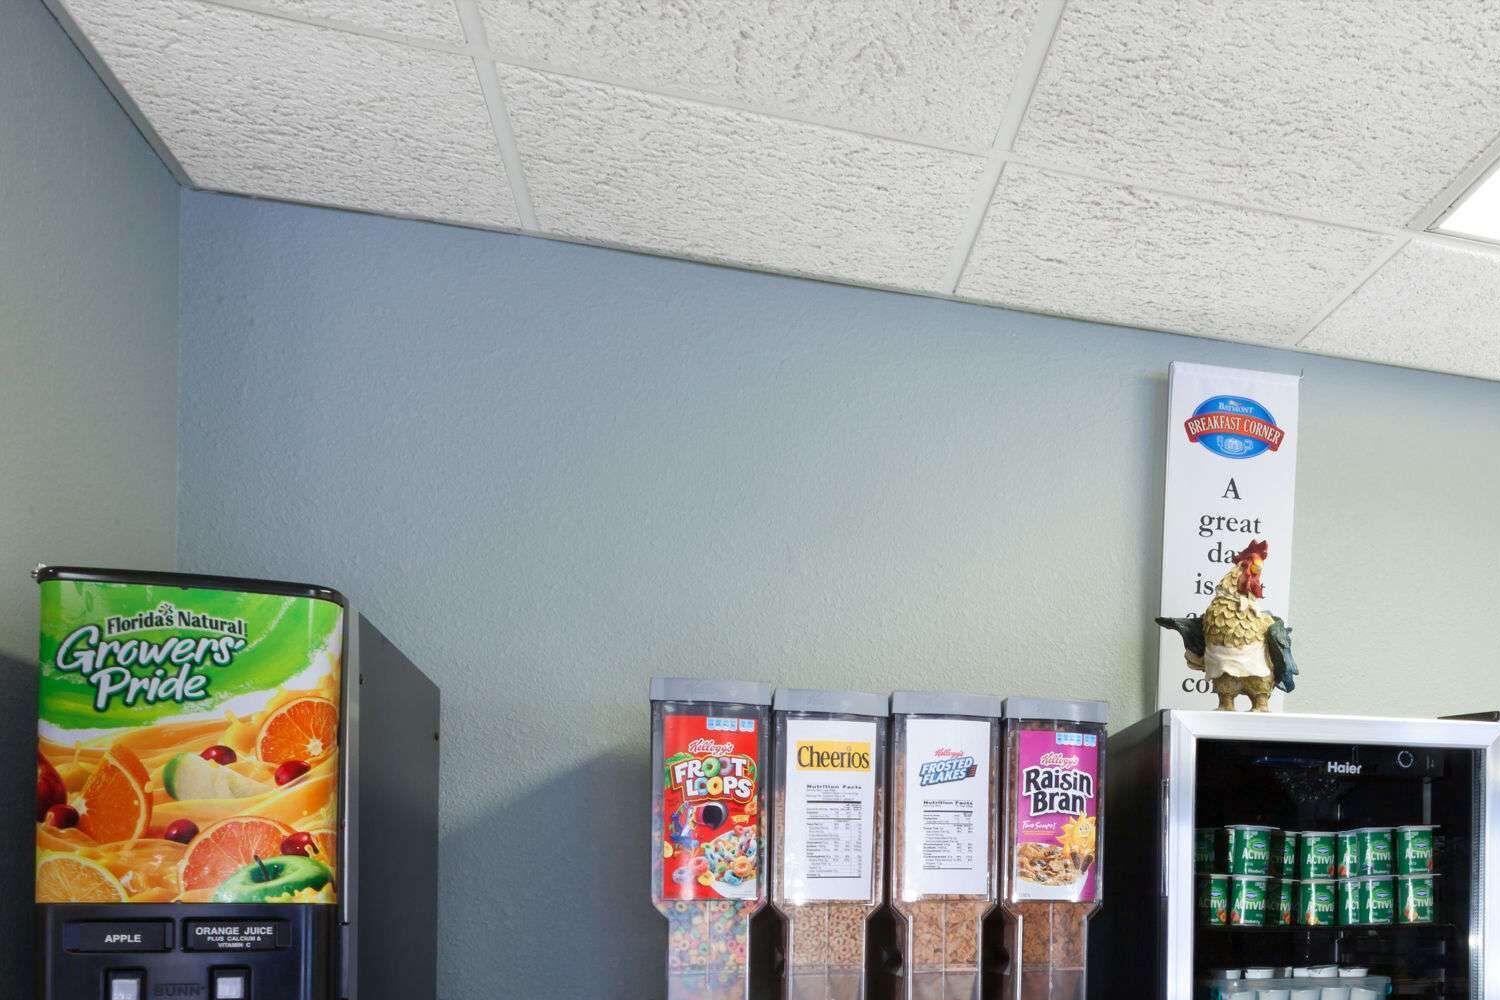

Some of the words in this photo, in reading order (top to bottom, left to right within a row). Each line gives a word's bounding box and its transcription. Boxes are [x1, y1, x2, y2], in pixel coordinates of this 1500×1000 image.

[1188, 416, 1242, 435] BREAKFAST
[1243, 419, 1281, 444] CORNER
[1222, 477, 1242, 500] A
[1199, 514, 1261, 538] great
[1207, 542, 1238, 564] da
[1194, 573, 1214, 595] is
[89, 663, 208, 711] Pride
[797, 745, 871, 769] Cheerios
[674, 756, 747, 784] FROOT
[921, 758, 973, 776] FROSTED
[1327, 761, 1362, 774] Haier
[922, 769, 967, 786] FLAKES
[1024, 768, 1092, 796] Raisin
[686, 775, 753, 799] LOOPS
[1032, 791, 1085, 814] Bran
[1242, 848, 1270, 860] ACTIVI
[1306, 853, 1335, 865] ACTIVI
[1365, 848, 1391, 861] ACTIVI
[1405, 848, 1433, 859] ACTIVI
[1307, 900, 1335, 913] ACTIVI
[1366, 899, 1392, 910] ACTIVI
[1406, 897, 1433, 908] ACTIVI
[104, 934, 142, 943] APPLE
[195, 926, 240, 936] ORANGE
[243, 926, 273, 935] JUICE
